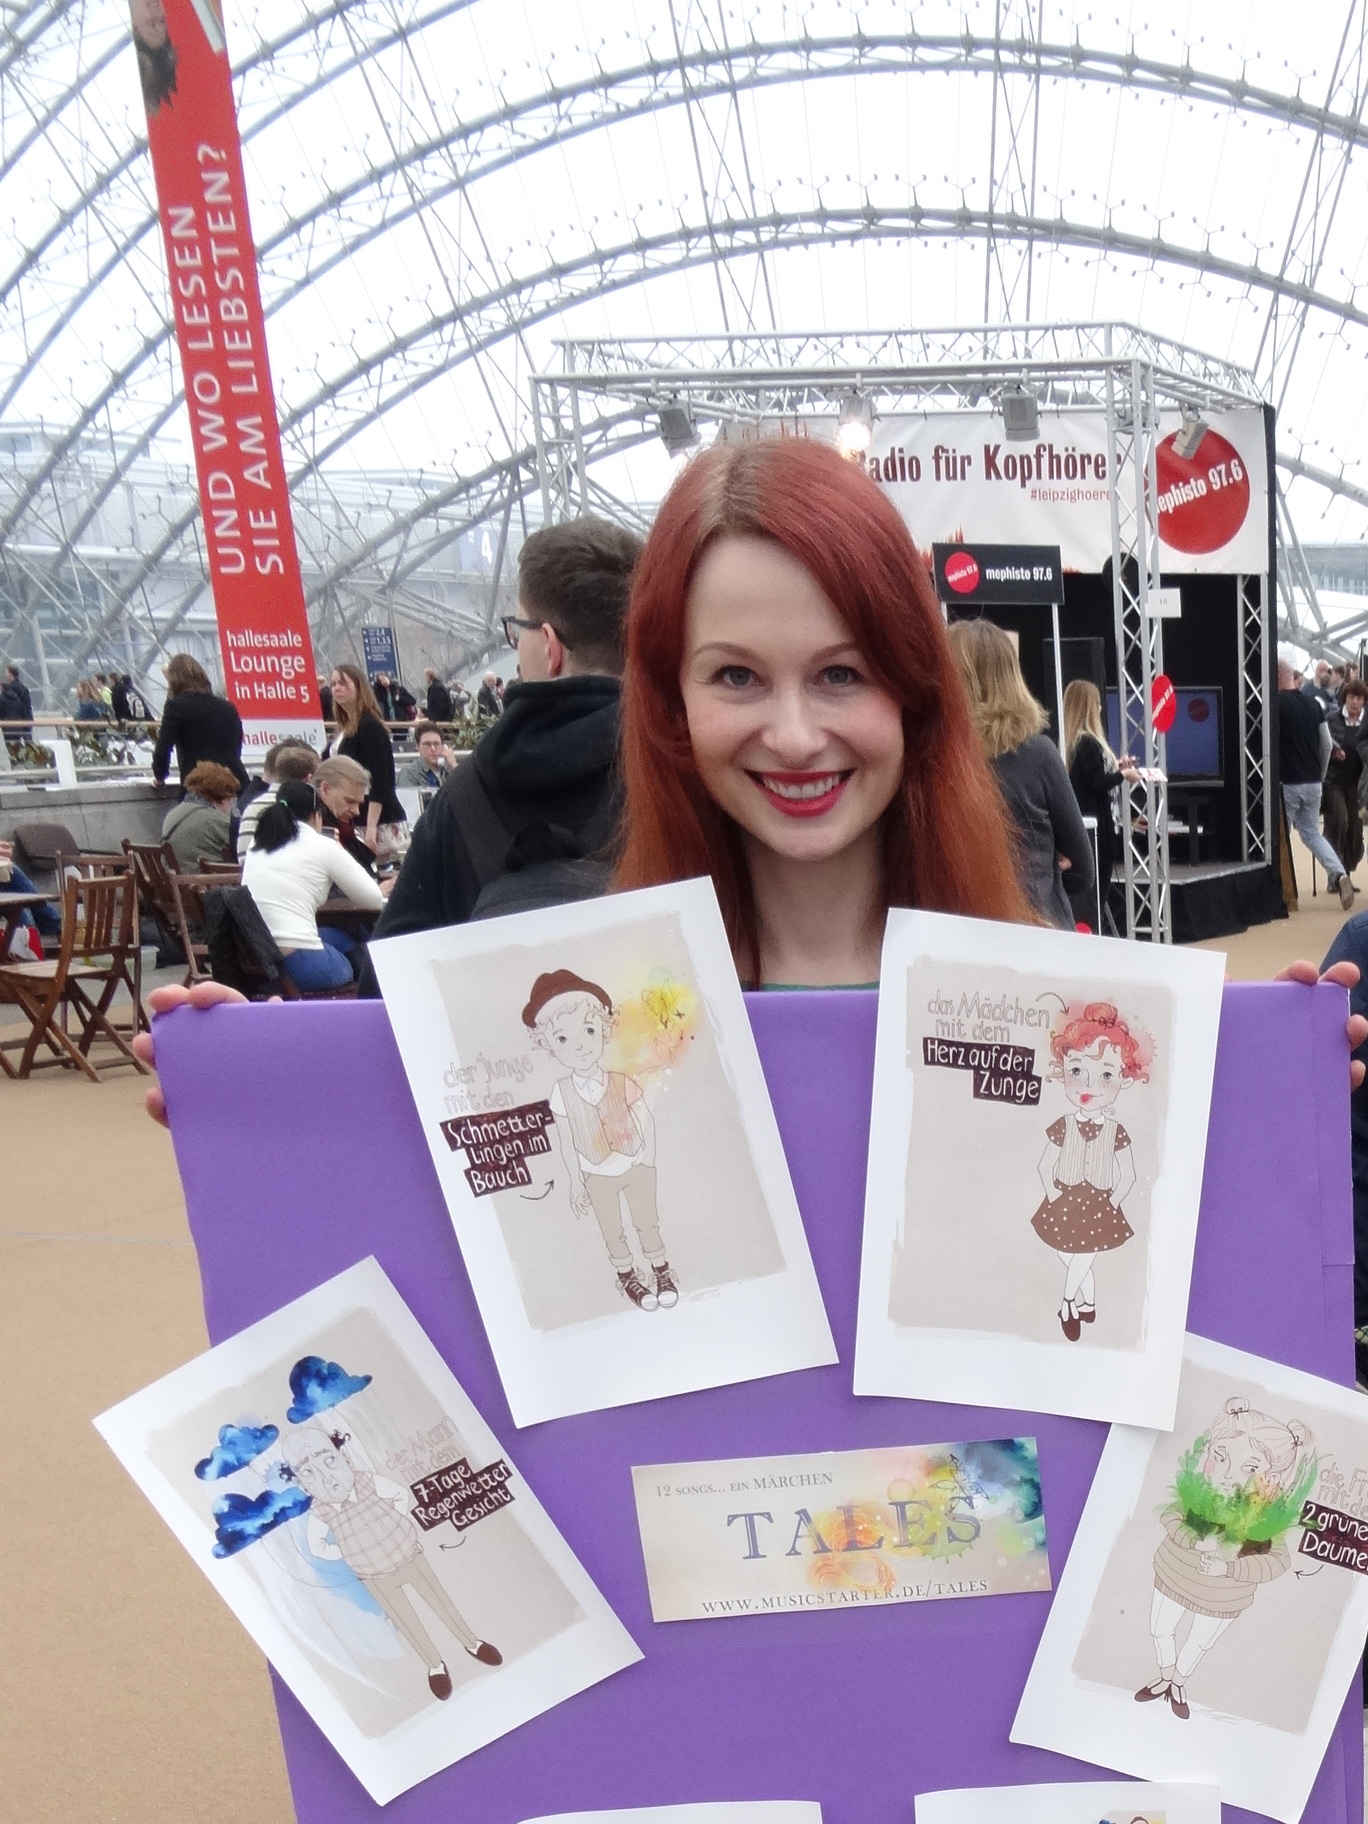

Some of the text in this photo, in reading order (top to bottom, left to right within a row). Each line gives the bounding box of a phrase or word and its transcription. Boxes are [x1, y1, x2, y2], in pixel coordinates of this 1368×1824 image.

[197, 143, 284, 575] SIE AM LIEBSTEN?
[168, 205, 246, 574] UND WO LESEN
[932, 445, 972, 481] für
[1157, 459, 1243, 514] ephisto 97.6
[986, 567, 1053, 582] mephisto 97.6
[227, 629, 302, 647] hallesaale
[230, 651, 306, 679] Lounge
[235, 681, 310, 703] in Halle 5
[927, 988, 1050, 1029] das Mädchen
[935, 1018, 1010, 1042] mit dem
[927, 1039, 1033, 1072] Herz auf der
[443, 1061, 477, 1088] der
[979, 1070, 1039, 1103] Zunge
[444, 1085, 515, 1114] mit den
[448, 1112, 551, 1147] Schmetter-
[529, 1134, 548, 1152] im
[471, 1160, 529, 1194] Bauch
[413, 1464, 471, 1503] 7-Tage
[655, 1485, 672, 1498] 12
[753, 1473, 834, 1490] MÄRCHEN
[1319, 1462, 1345, 1488] die
[414, 1463, 509, 1526] Regenwetter
[451, 1487, 511, 1526] Gesicht
[1317, 1484, 1350, 1509] mit
[726, 1495, 984, 1560] TALES
[1302, 1504, 1317, 1524] 2
